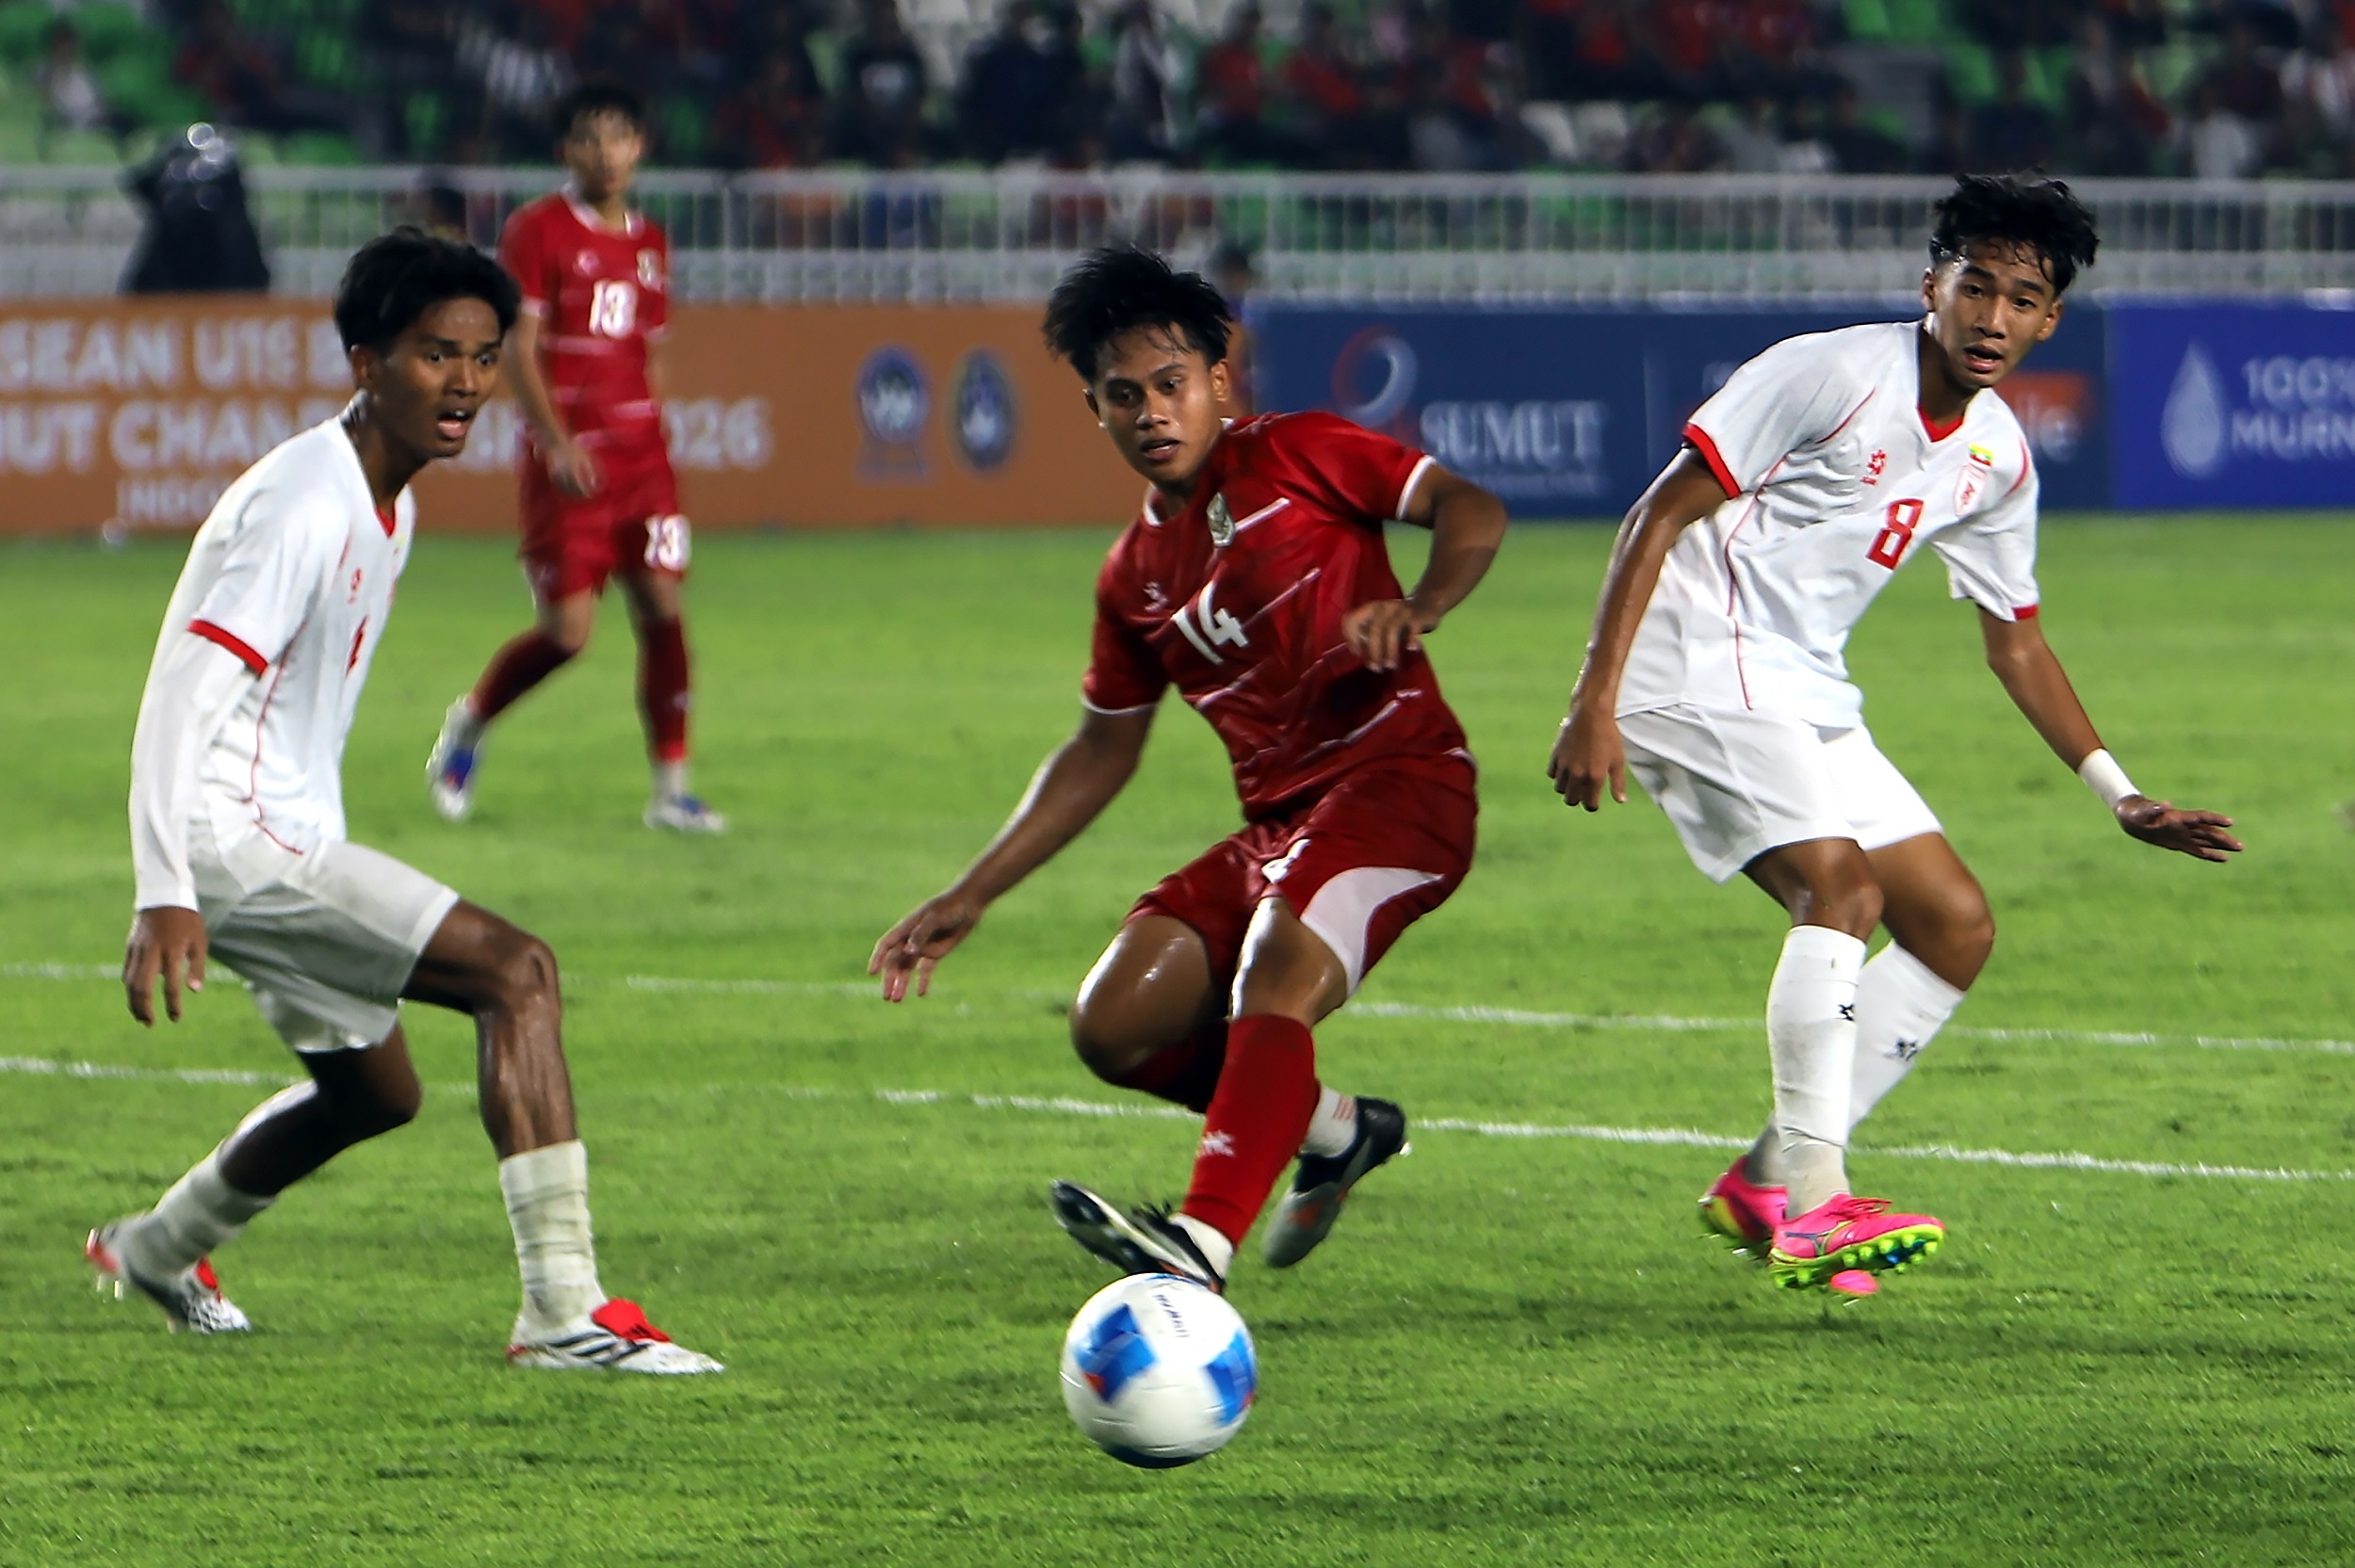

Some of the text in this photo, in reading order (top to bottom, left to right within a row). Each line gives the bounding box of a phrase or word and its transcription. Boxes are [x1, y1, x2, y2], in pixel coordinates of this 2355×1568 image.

[590, 279, 640, 340] 13
[0, 401, 98, 475] UT
[1420, 399, 1609, 469] SUMUT
[644, 513, 691, 572] 13
[1864, 498, 1925, 571] 8
[1171, 578, 1249, 665] 14
